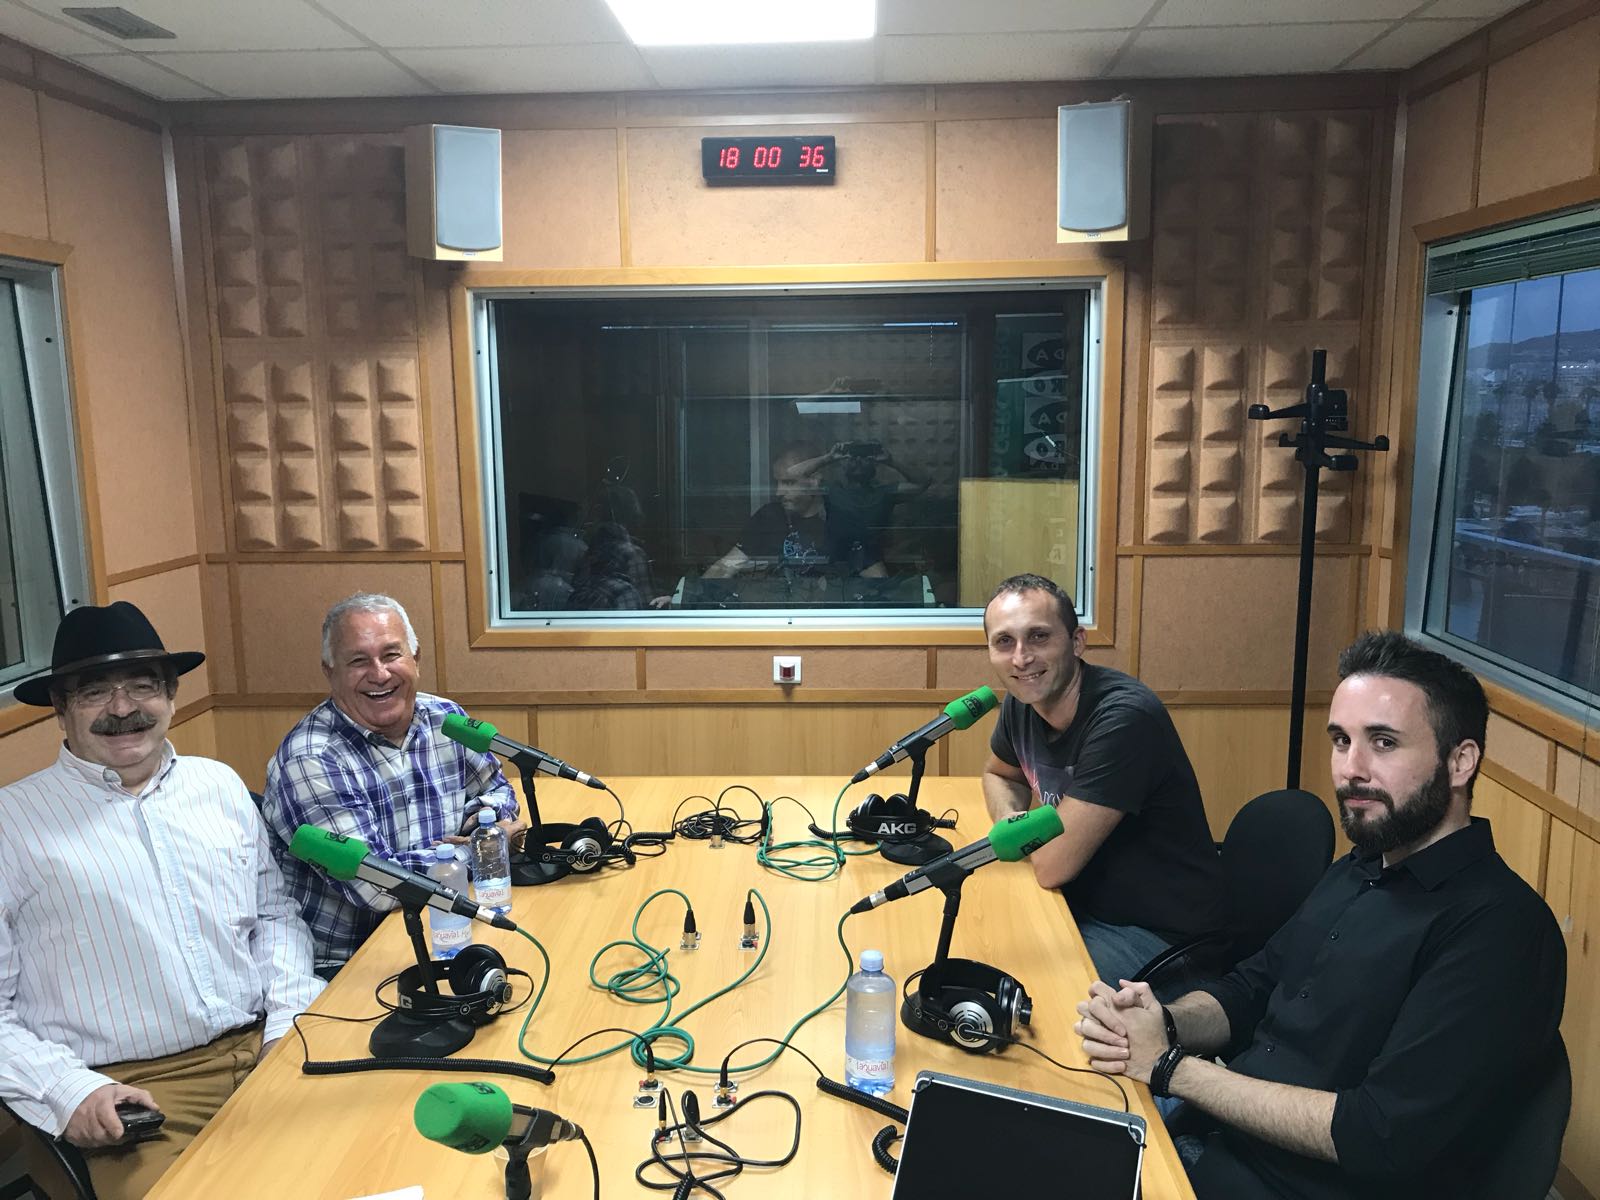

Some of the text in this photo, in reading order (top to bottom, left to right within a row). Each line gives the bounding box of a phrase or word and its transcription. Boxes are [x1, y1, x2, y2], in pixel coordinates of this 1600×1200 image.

[720, 146, 825, 169] 18 00 36
[878, 822, 917, 834] AKG
